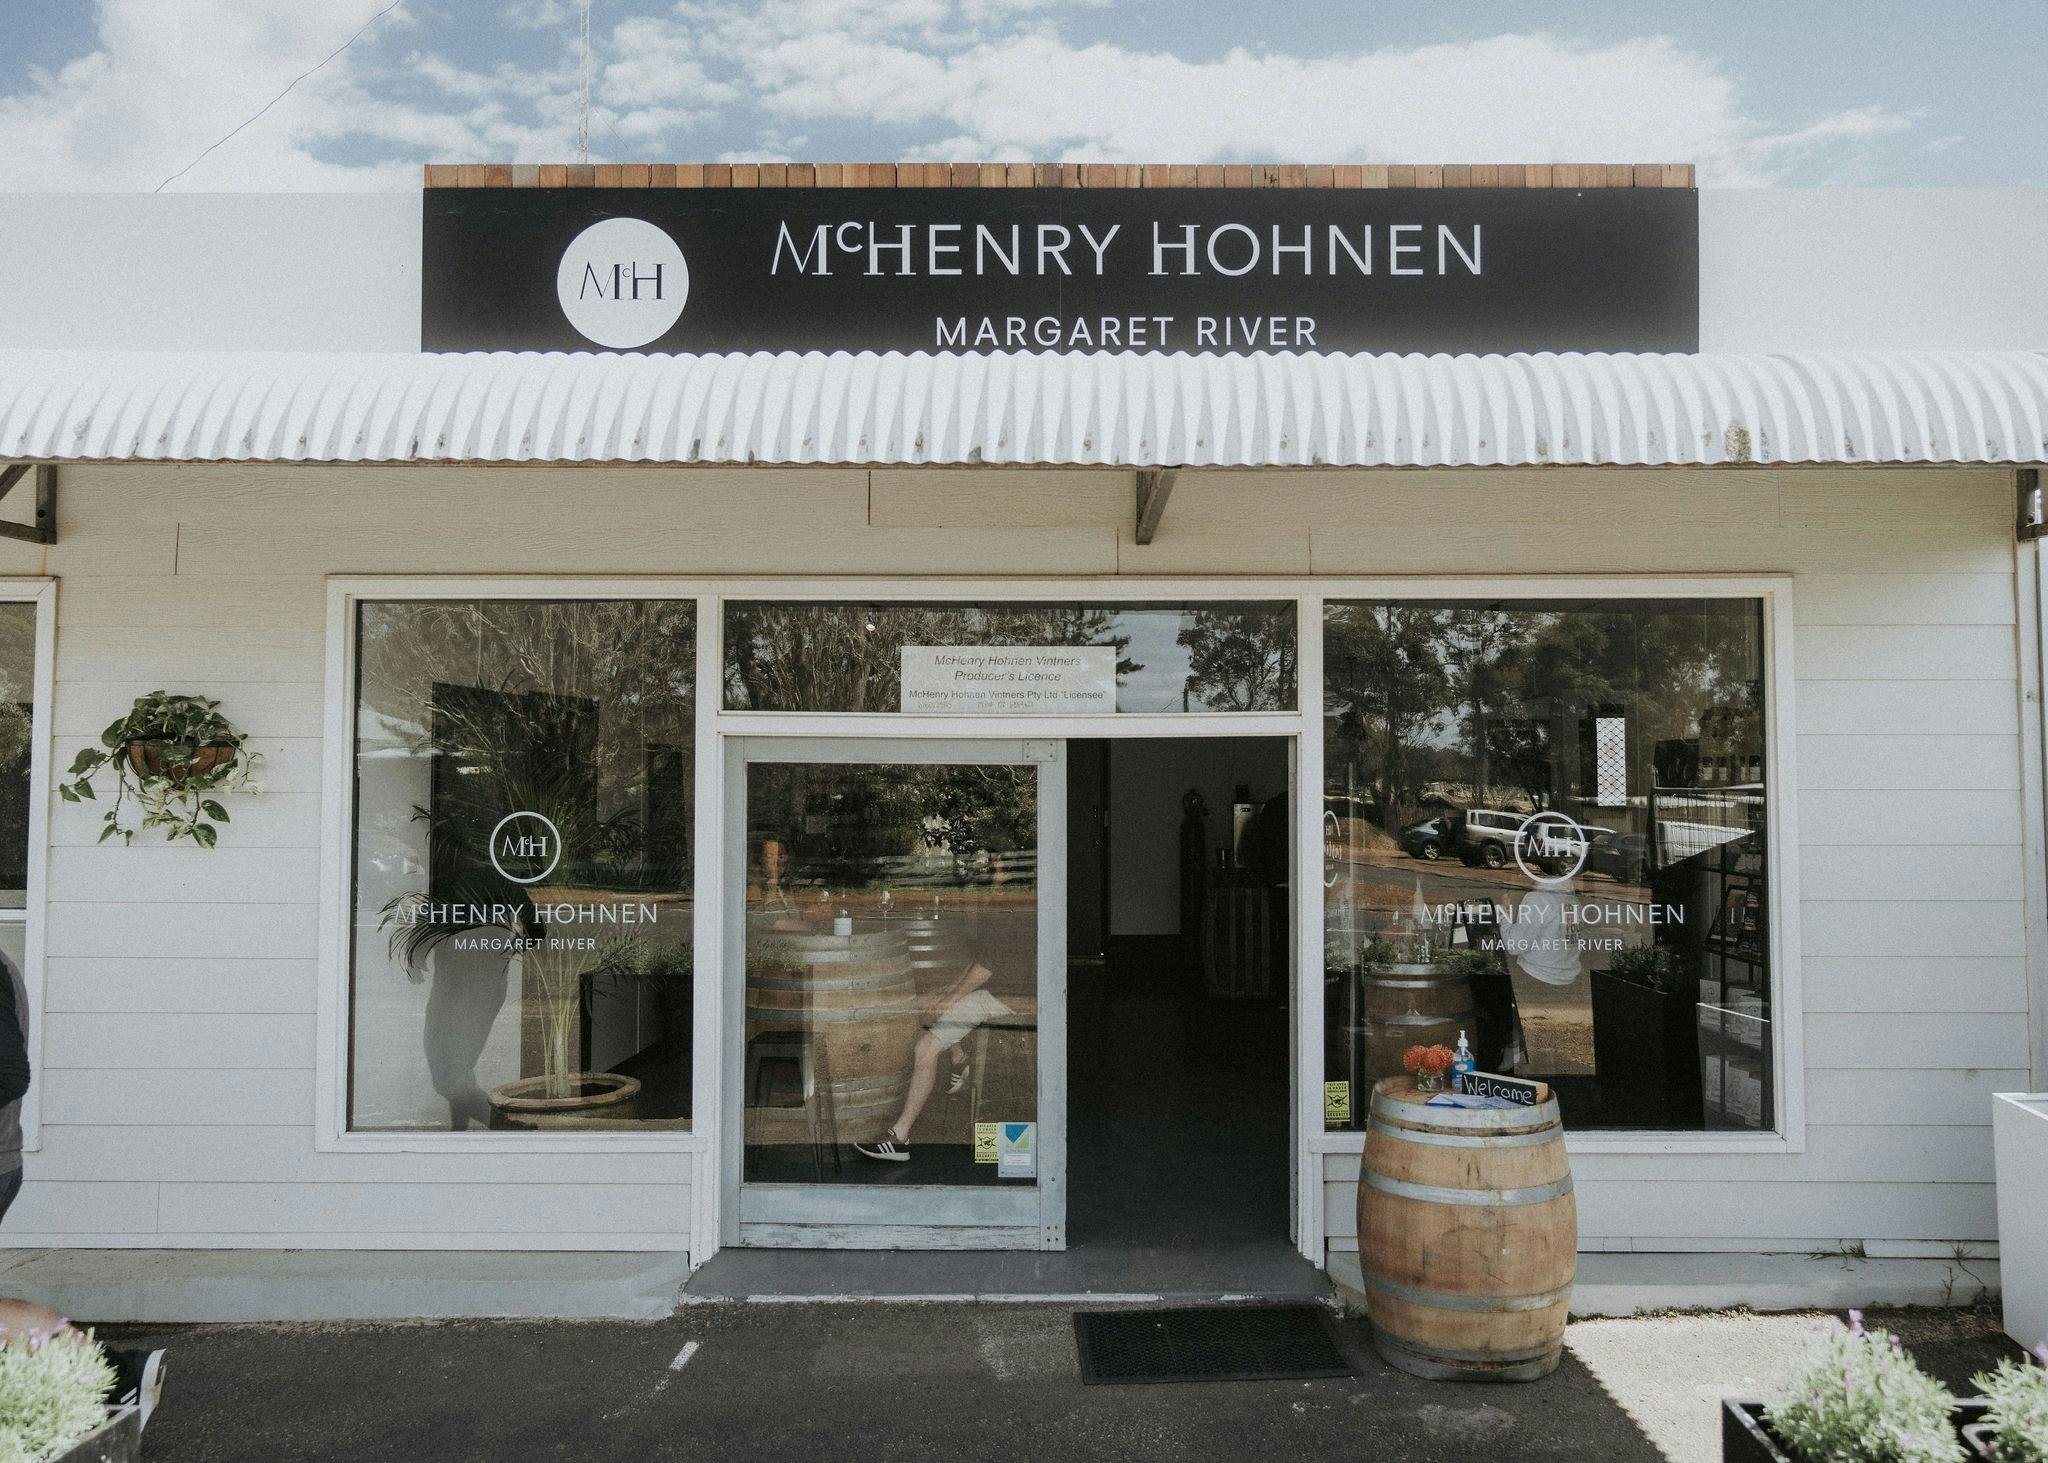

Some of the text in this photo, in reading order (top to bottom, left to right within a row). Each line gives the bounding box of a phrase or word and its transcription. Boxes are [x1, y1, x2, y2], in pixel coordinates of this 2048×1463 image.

[770, 219, 1483, 277] McHENRY HOHNEN
[579, 259, 667, 300] McH
[936, 316, 1318, 347] MARGARET RIVER
[935, 655, 1082, 667] McHenry Hohnen Vintners
[954, 670, 1062, 682] Producer's Licence
[909, 690, 949, 700] McHenry
[951, 690, 986, 699] Hohnen
[989, 690, 1025, 699] Vintners
[1027, 690, 1042, 701] Pty
[1044, 690, 1058, 699] Ltd
[502, 835, 549, 857] McH
[395, 903, 657, 924] McHENRY HOHNEN
[1420, 902, 1684, 925] McHENRY HOHNEN
[454, 938, 596, 950] MARGARET RIVER
[1481, 938, 1570, 951] MARGARET
[1577, 938, 1623, 951] RIVER
[1463, 1075, 1534, 1105] Welcome
